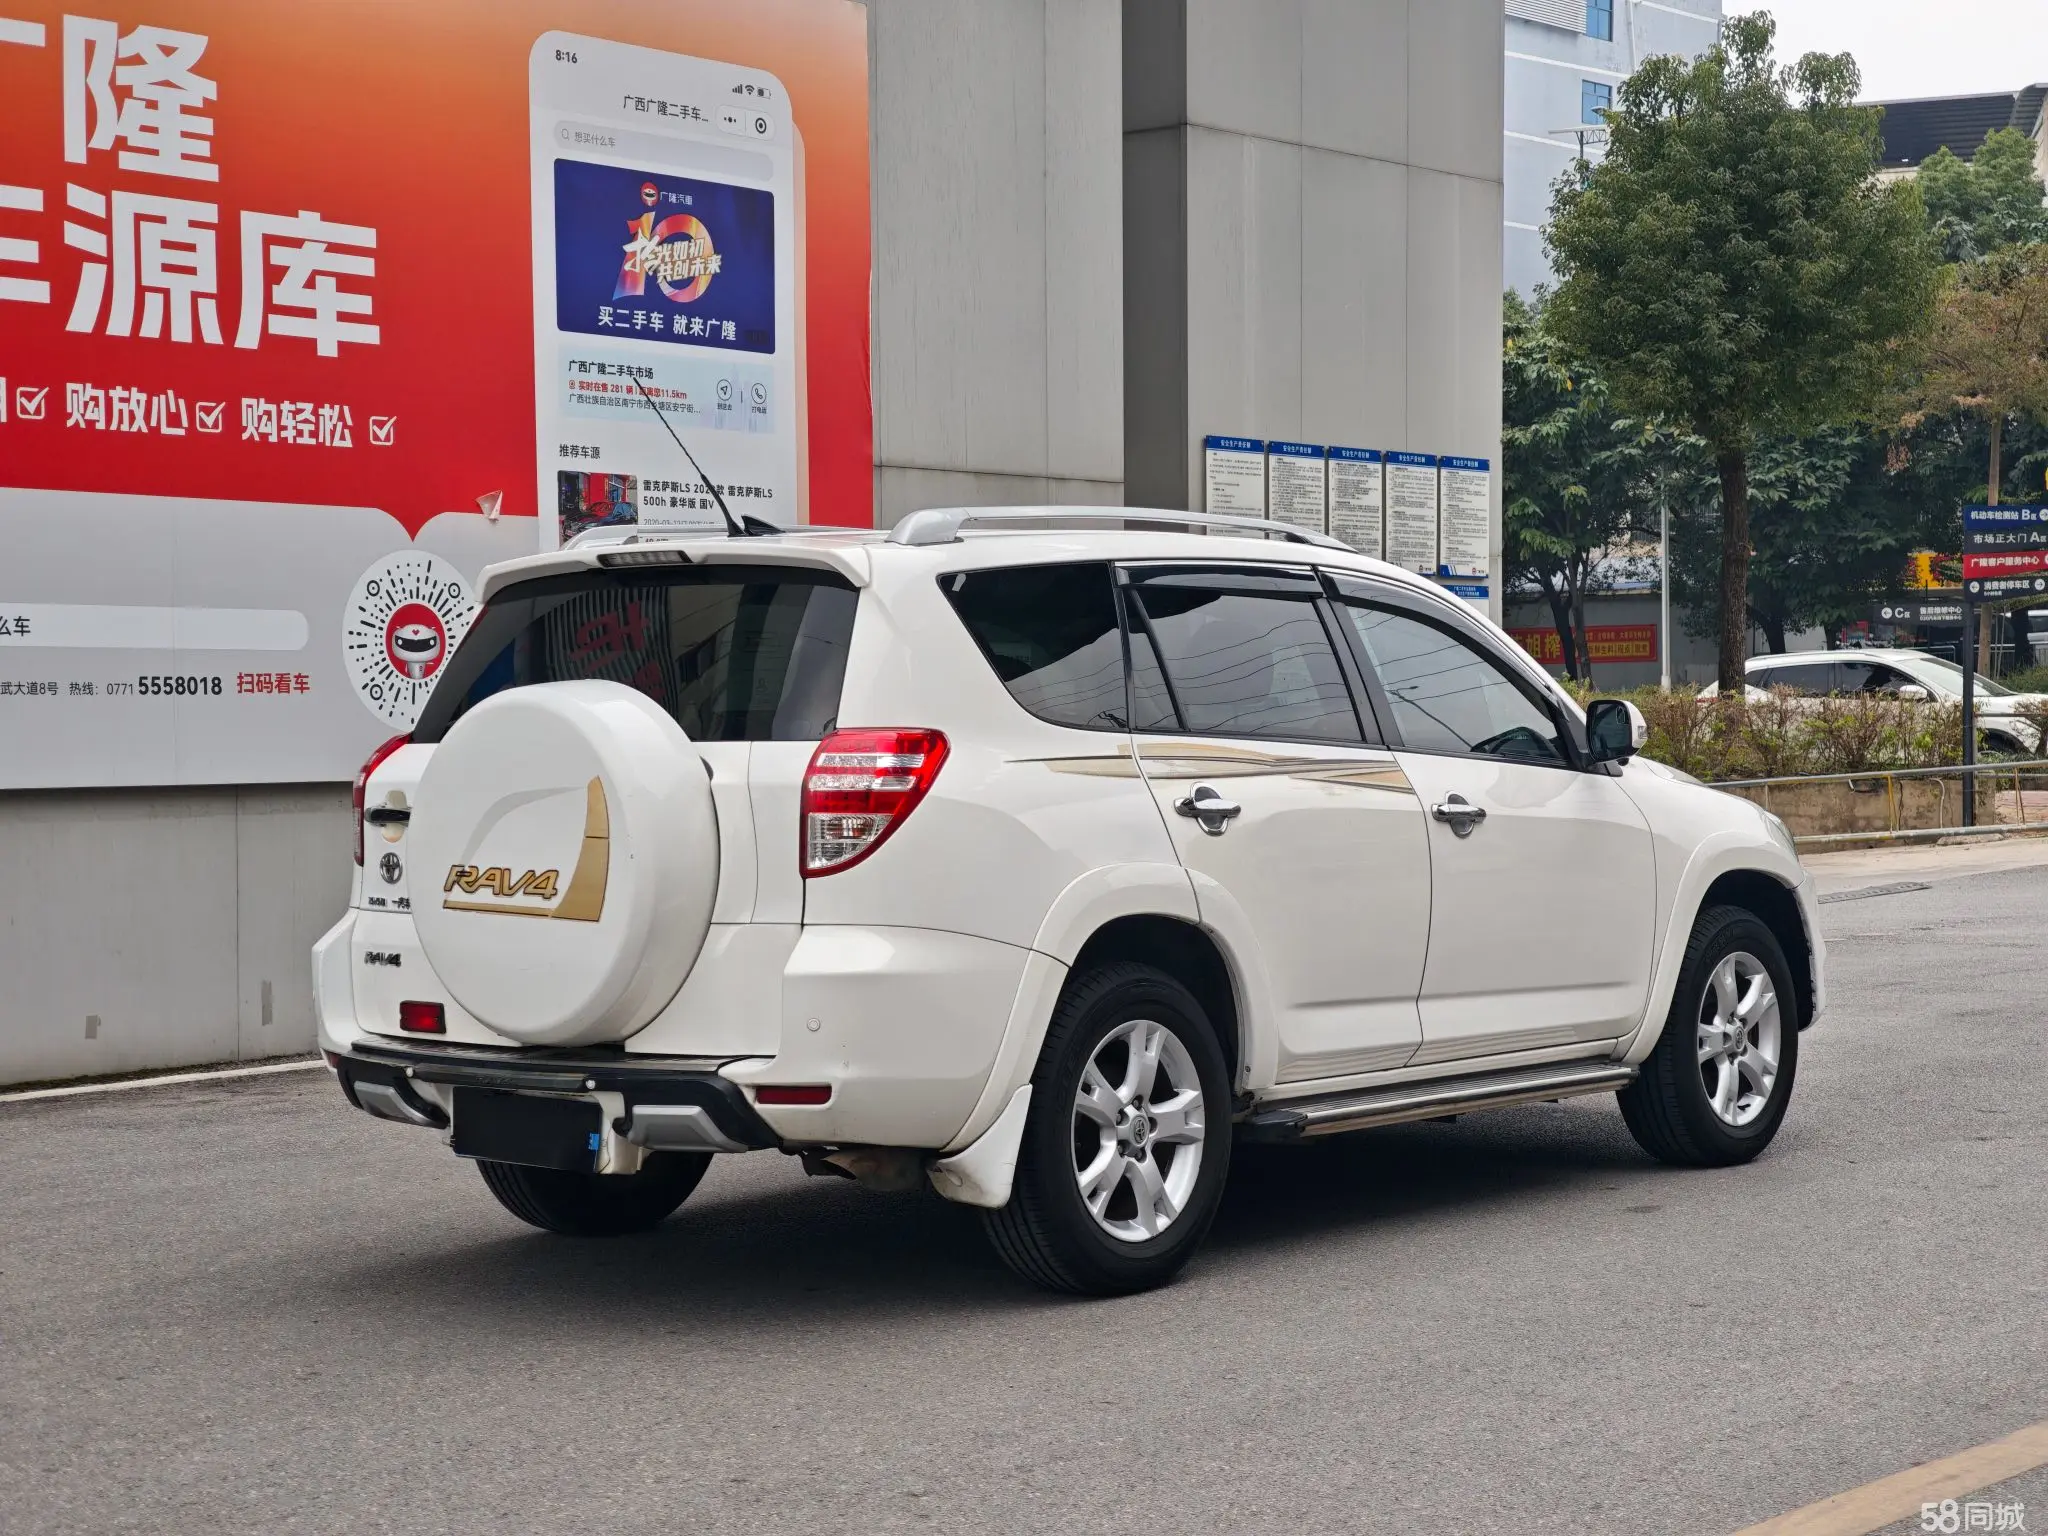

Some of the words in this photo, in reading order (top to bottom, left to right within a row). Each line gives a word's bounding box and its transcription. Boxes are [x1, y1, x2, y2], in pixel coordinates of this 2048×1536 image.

[555, 50, 578, 64] 8:16
[574, 131, 616, 148] 想买什么车
[598, 305, 665, 333] 买二手车
[672, 314, 737, 341] 就来广隆
[568, 359, 654, 380] 广西广隆二手车市场
[578, 380, 609, 393] 实时在售
[610, 384, 624, 393] 281
[66, 382, 188, 436] 购放心
[241, 397, 354, 449] 购轻松
[559, 444, 601, 460] 推荐车源
[643, 479, 691, 494] 雷克萨斯LS
[727, 485, 773, 499] 雷克萨斯LS
[643, 495, 667, 508] 500h
[669, 497, 697, 509] 豪华版
[1970, 510, 2019, 521] 机动车检测站
[1973, 532, 2028, 545] 市场正大门
[106, 683, 134, 695] 0771
[138, 675, 223, 696] 5558018
[236, 673, 311, 695] 扫码看车
[444, 864, 560, 900] RAV4
[364, 951, 402, 968] RAV4
